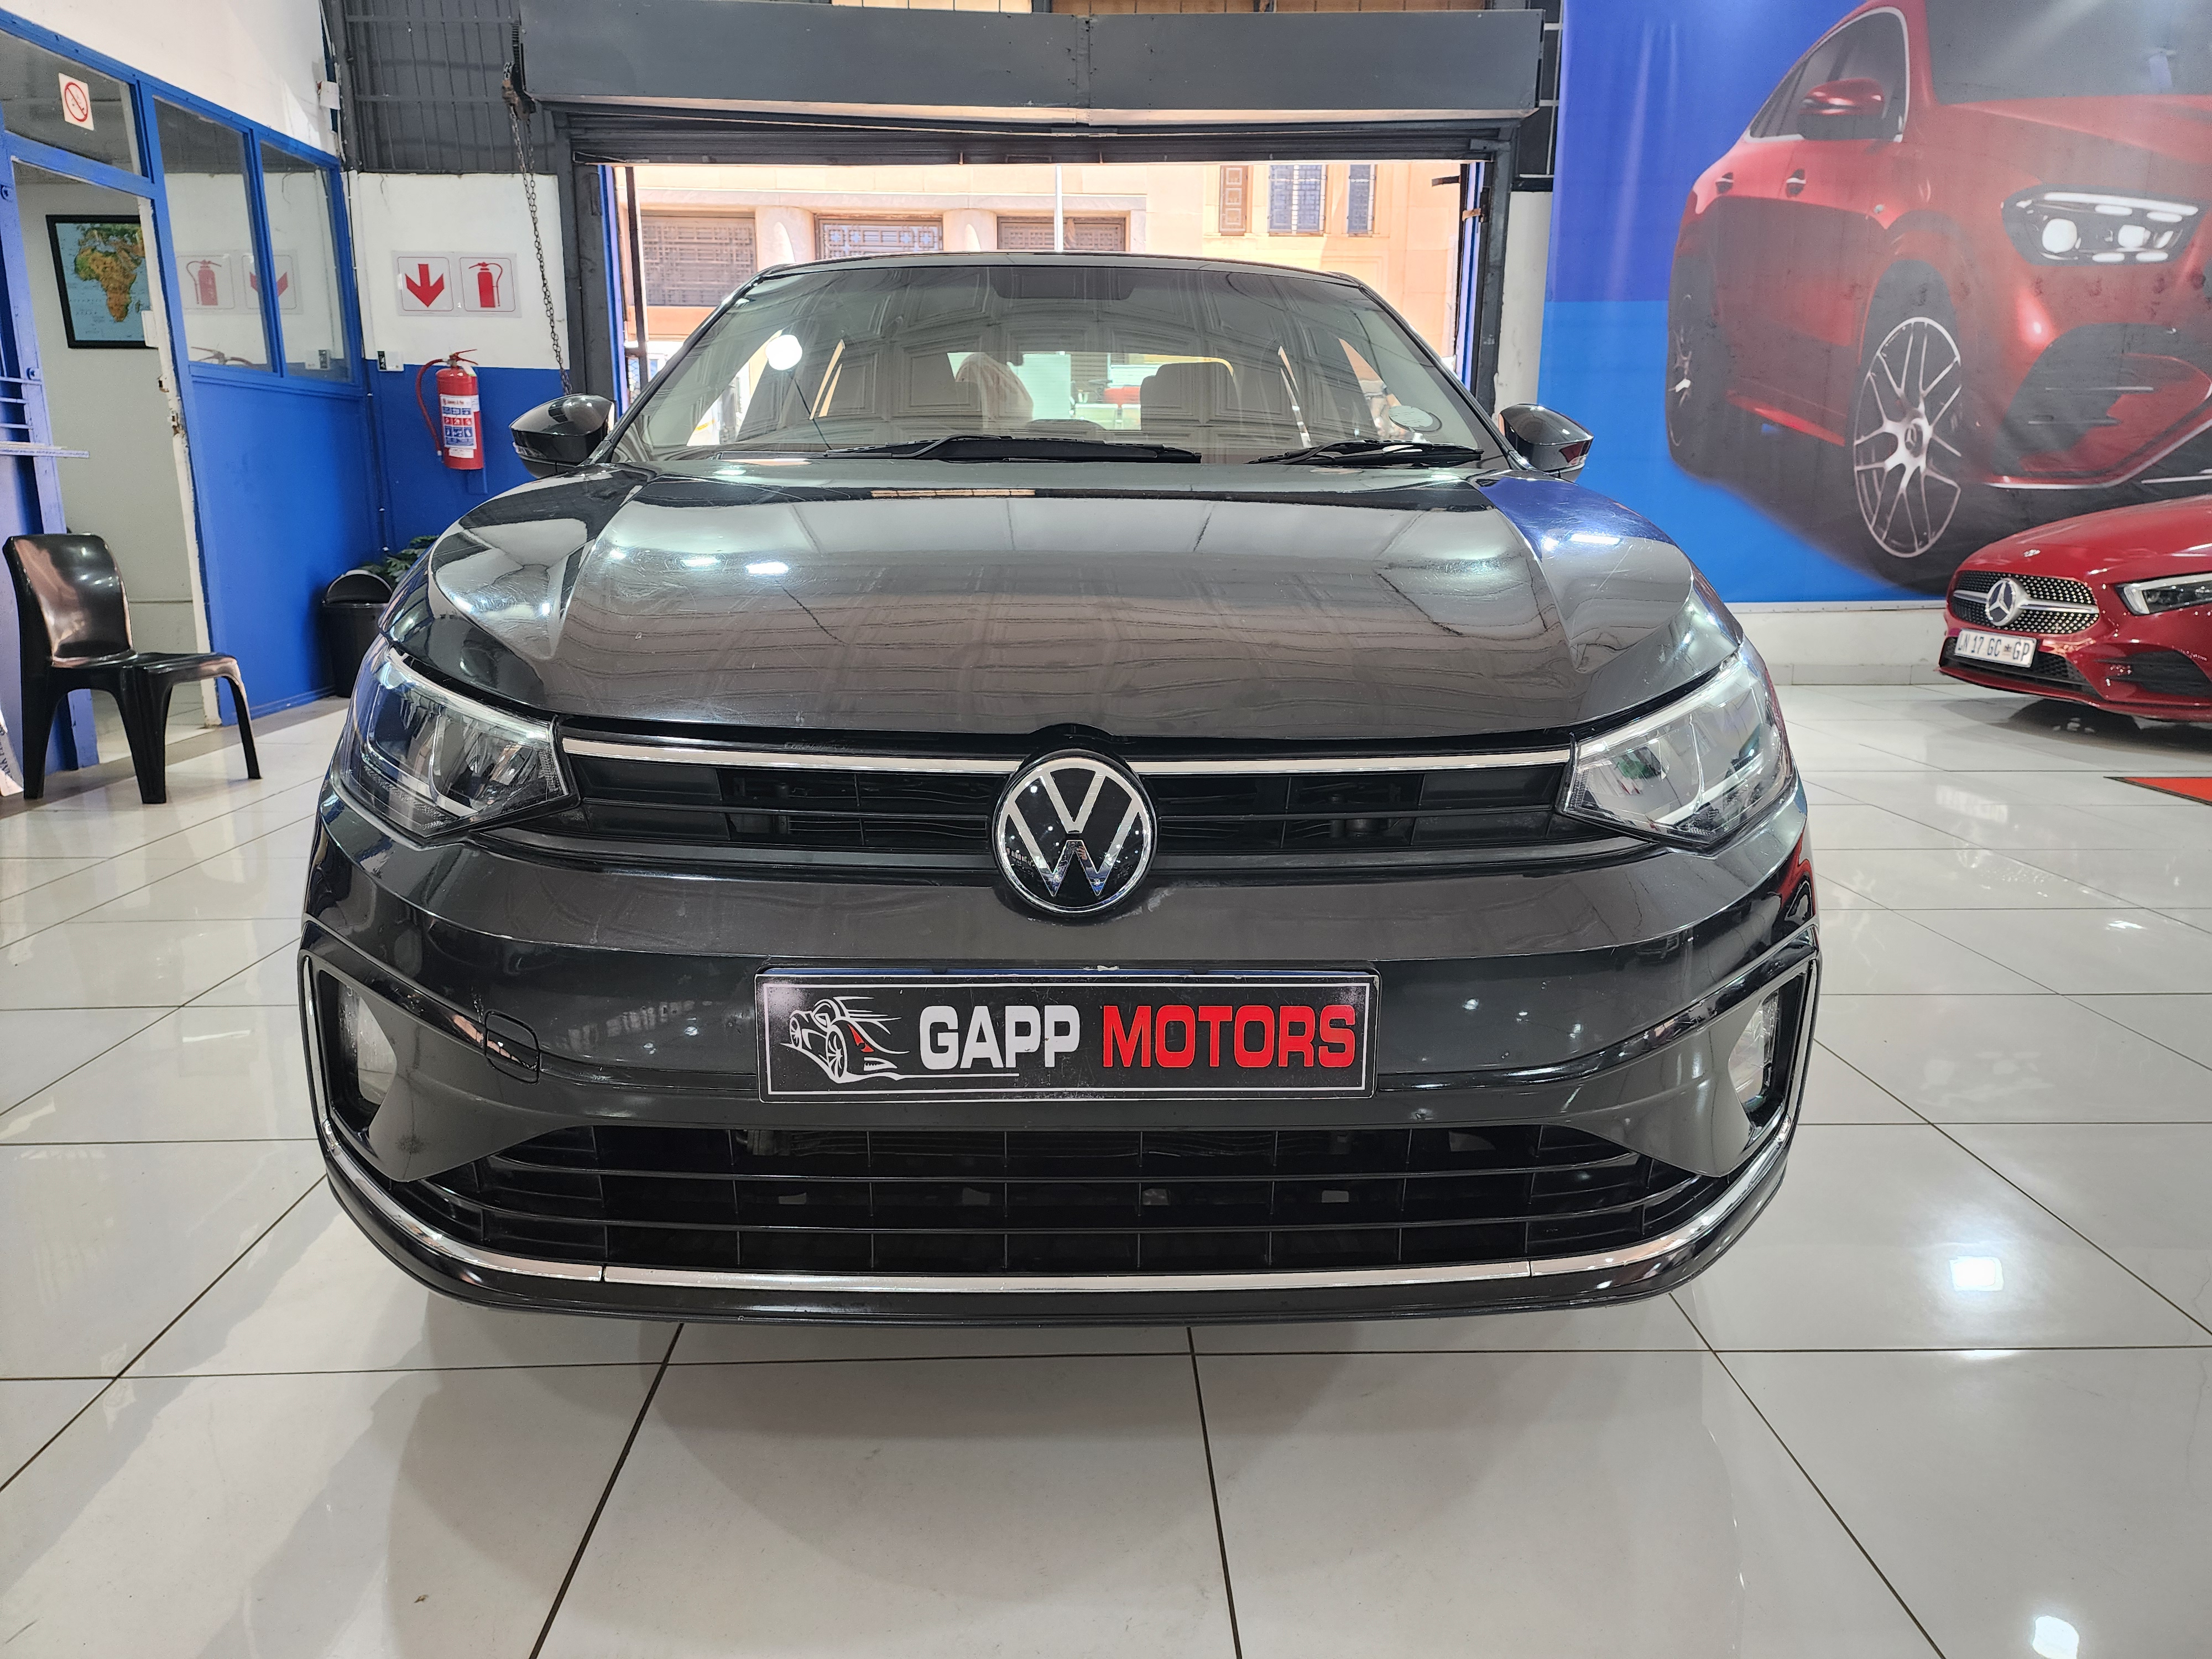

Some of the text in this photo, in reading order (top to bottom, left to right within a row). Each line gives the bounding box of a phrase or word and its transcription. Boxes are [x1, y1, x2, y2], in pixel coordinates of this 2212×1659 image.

[1971, 635, 1984, 653] 17
[1987, 638, 2002, 656] GC
[2012, 641, 2030, 661] GP
[920, 1004, 1357, 1068] GAPP MOTORS
